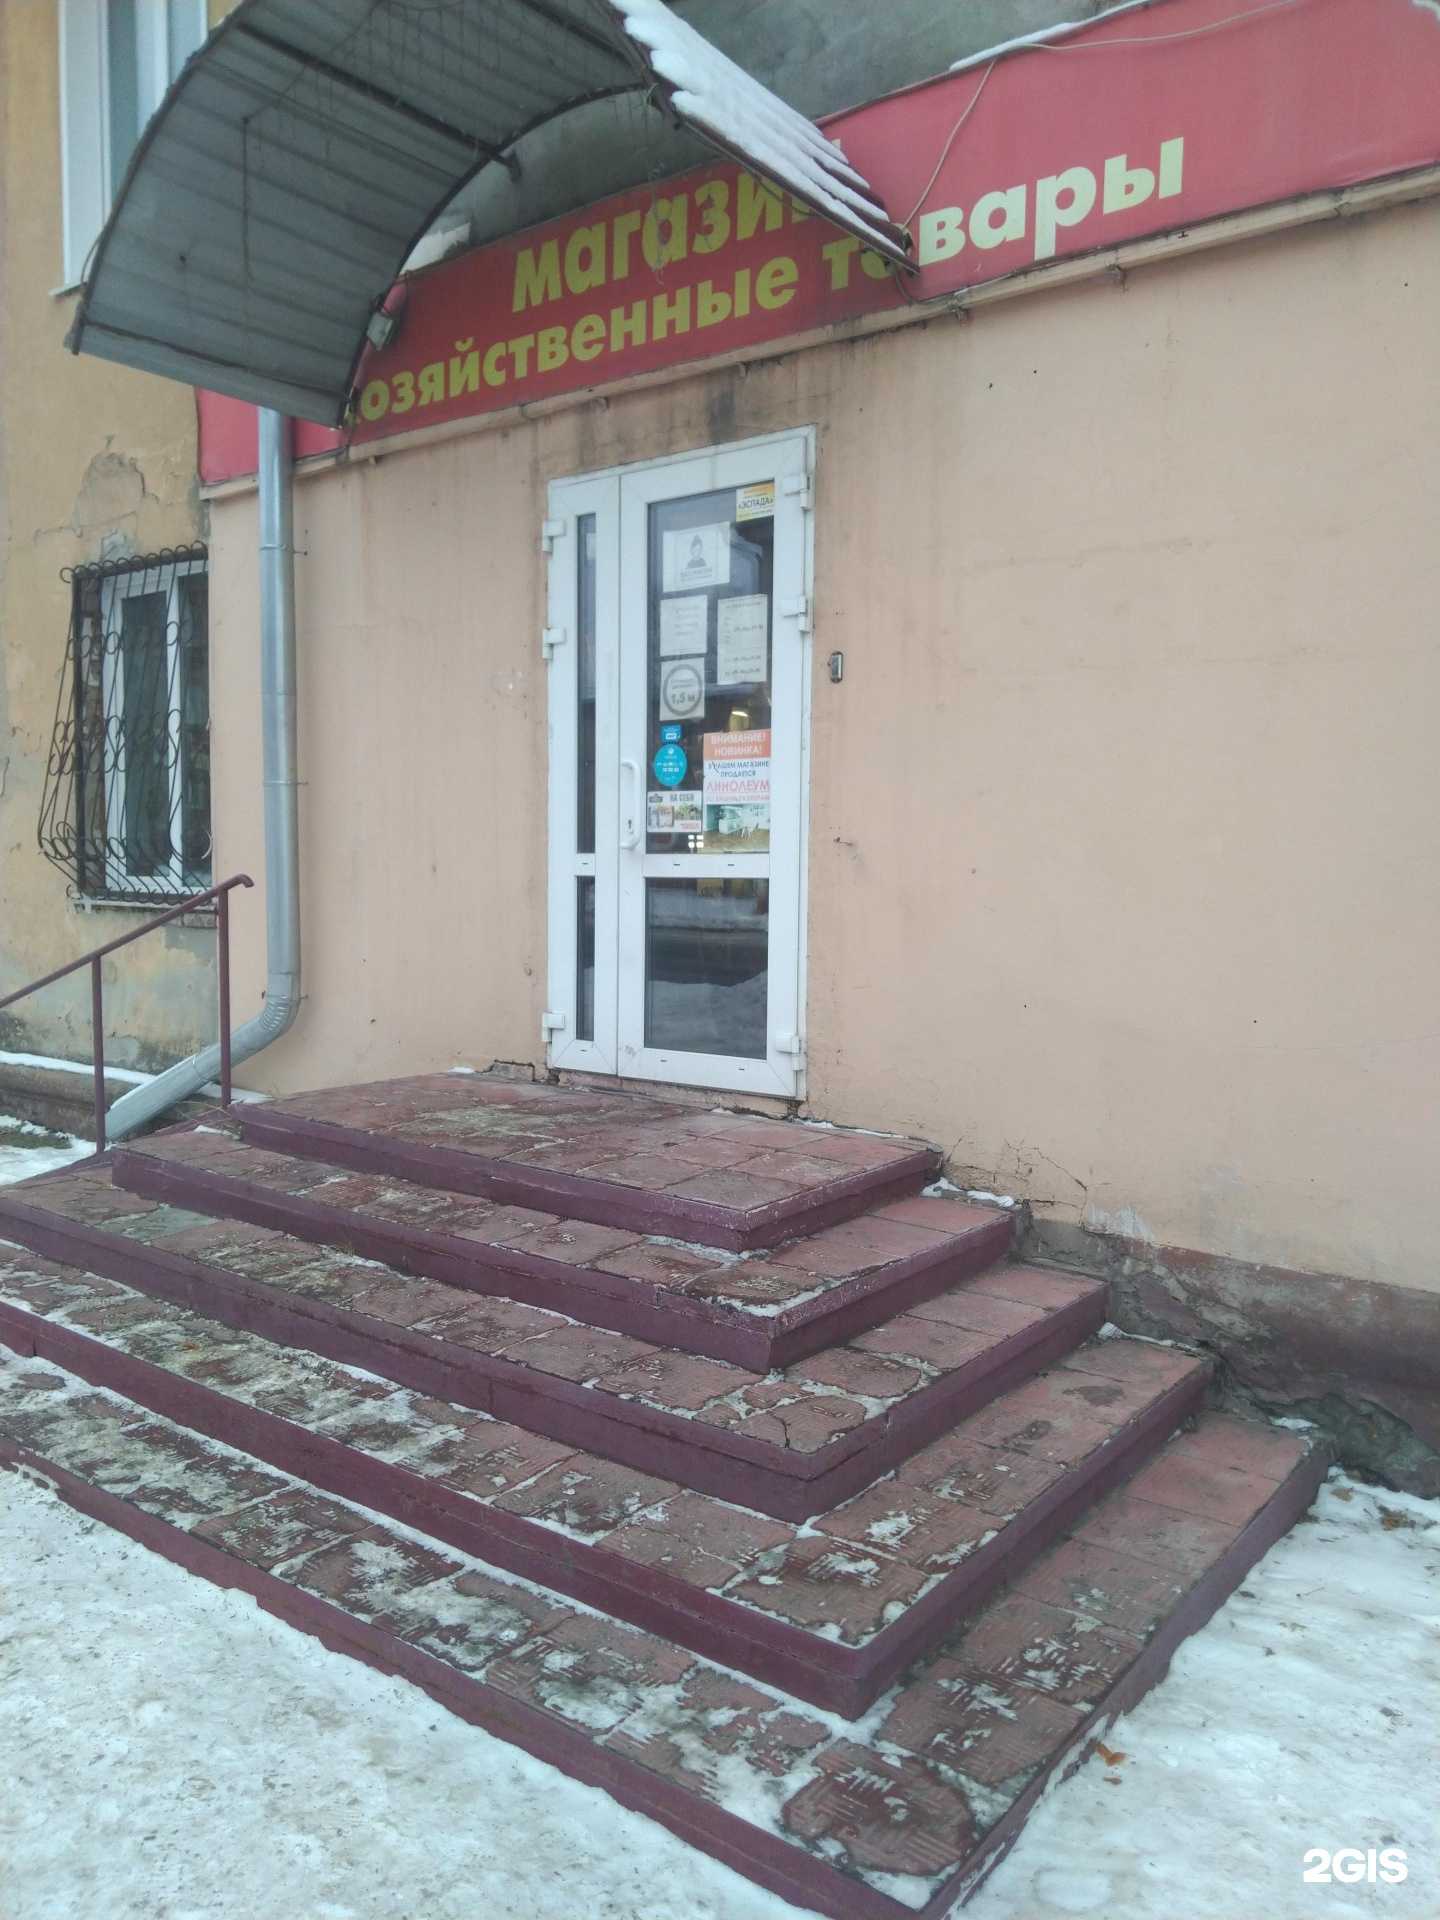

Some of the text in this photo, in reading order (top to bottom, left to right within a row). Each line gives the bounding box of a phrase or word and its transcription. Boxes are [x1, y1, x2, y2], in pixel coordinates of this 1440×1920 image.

[512, 160, 825, 313] магази
[346, 256, 799, 421] озяйственные
[671, 692, 685, 705] 1,5
[737, 760, 769, 768] МАГАЗИНЕ
